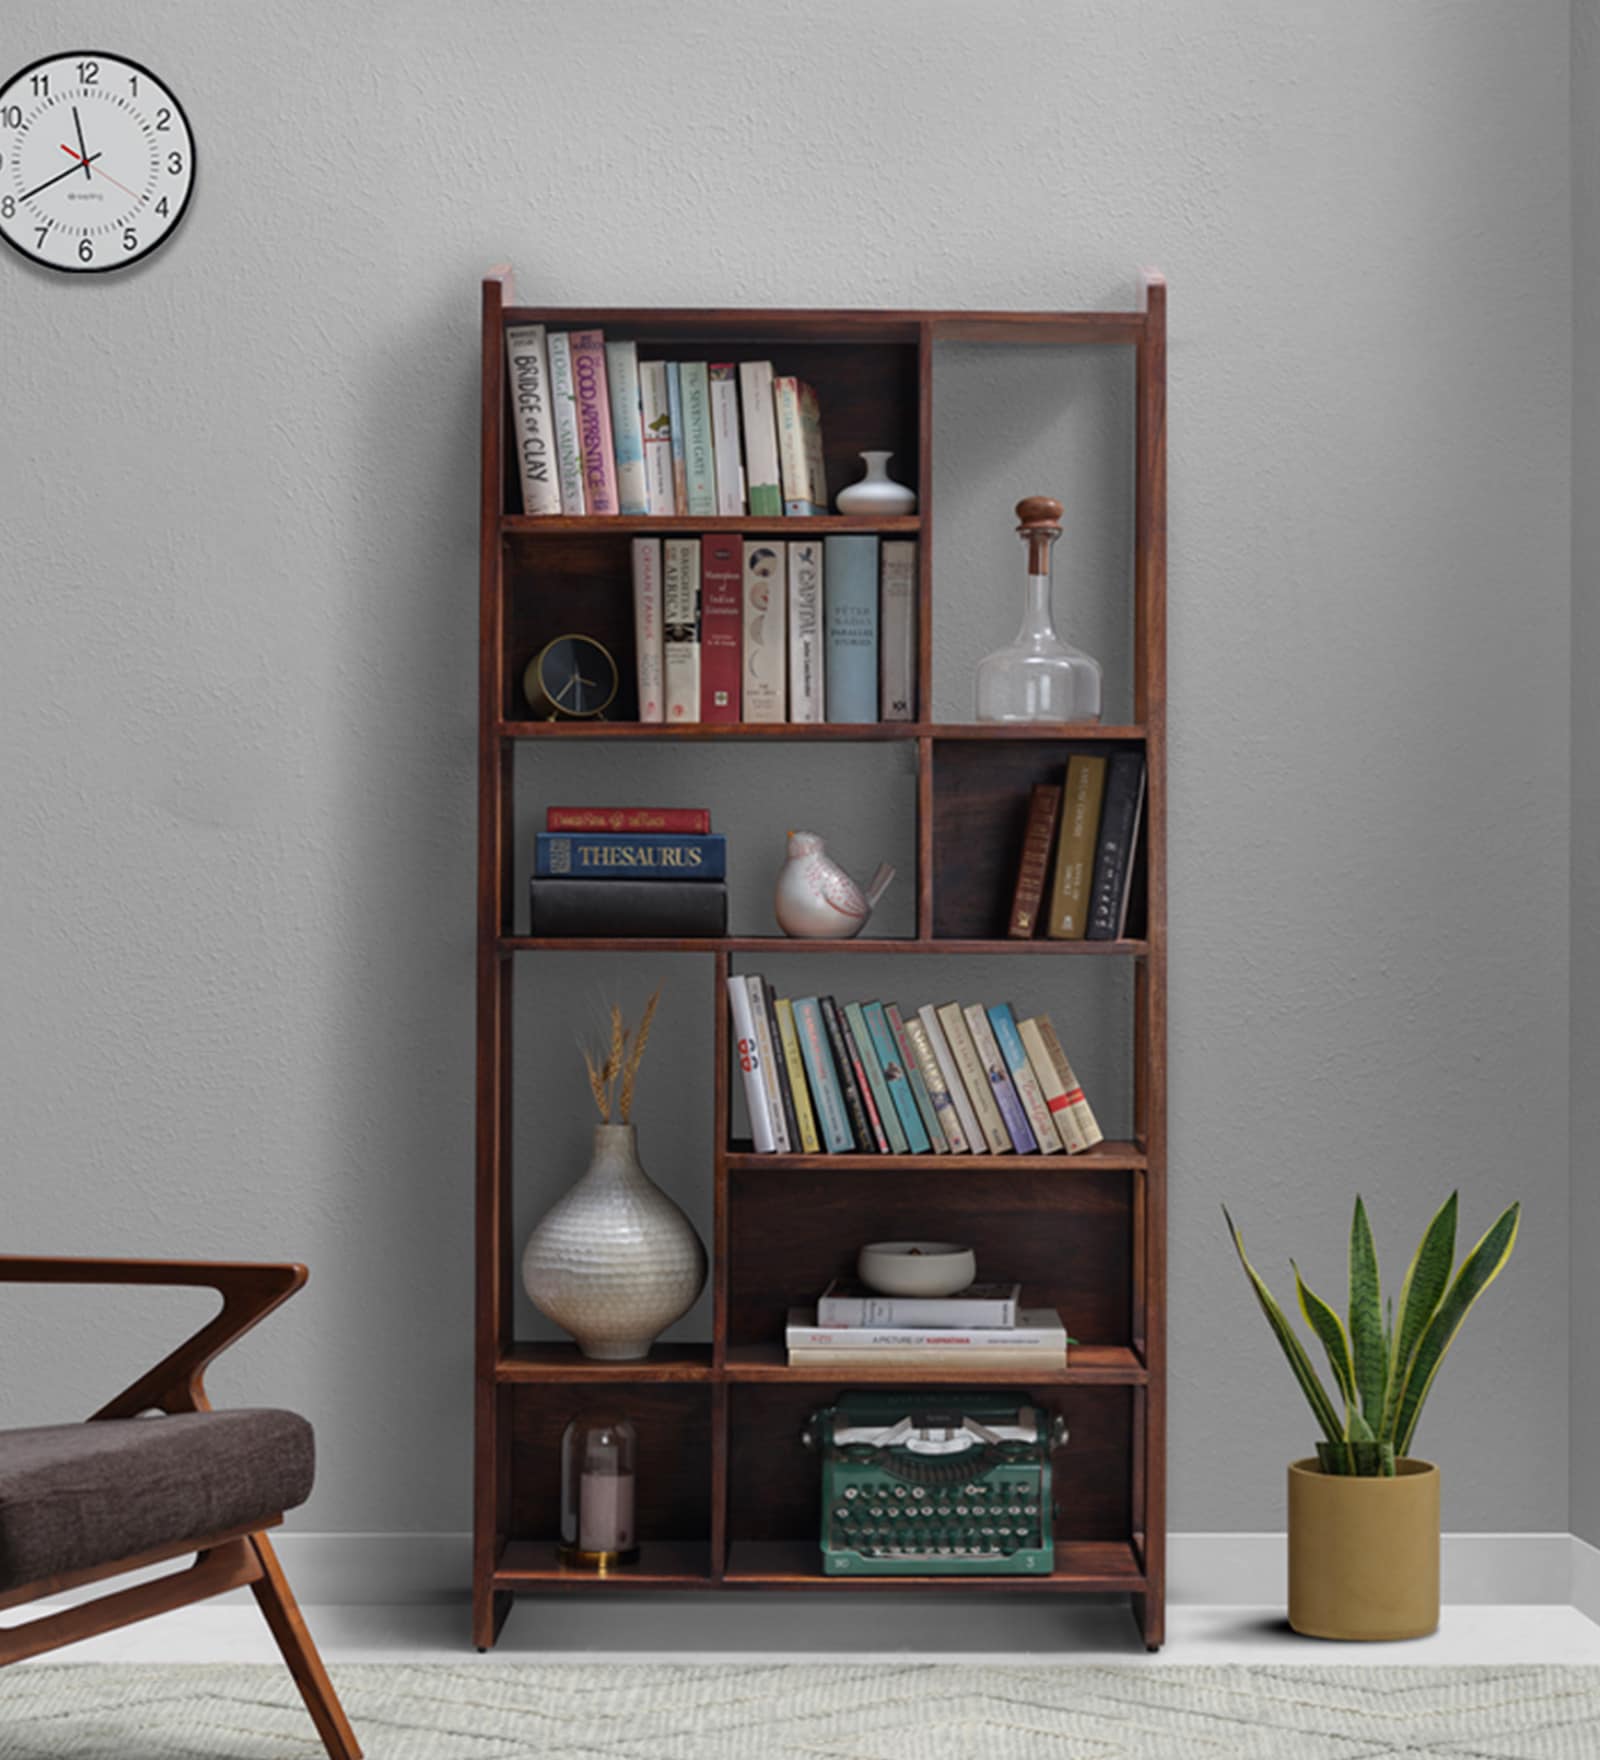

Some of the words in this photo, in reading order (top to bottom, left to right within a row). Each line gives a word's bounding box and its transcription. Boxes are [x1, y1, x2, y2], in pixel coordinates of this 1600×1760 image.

[31, 75, 49, 97] 11
[77, 61, 99, 84] 12
[128, 76, 138, 97] 1
[1, 105, 22, 128] 10
[156, 107, 171, 131] 2
[168, 152, 183, 175] 3
[1, 195, 16, 218] 8
[155, 196, 169, 218] 4
[34, 227, 49, 249] 7
[78, 238, 93, 262] 6
[123, 228, 137, 251] 5
[551, 337, 569, 397] GEORGE
[574, 355, 597, 401] GOOD
[514, 356, 542, 413] BRIDGE
[689, 389, 704, 444] SEVENTH
[522, 439, 548, 483] CLAY
[559, 418, 577, 500] SAUNDERS
[580, 402, 606, 489] APPRENTICE
[692, 446, 705, 477] GATE
[641, 545, 652, 592] ORHAN
[680, 547, 690, 620] DAUGHTERS
[666, 565, 677, 619] AFRICA
[797, 570, 816, 639] CAPITAL
[644, 595, 654, 640] PAMUK
[577, 846, 703, 867] THESAURUS
